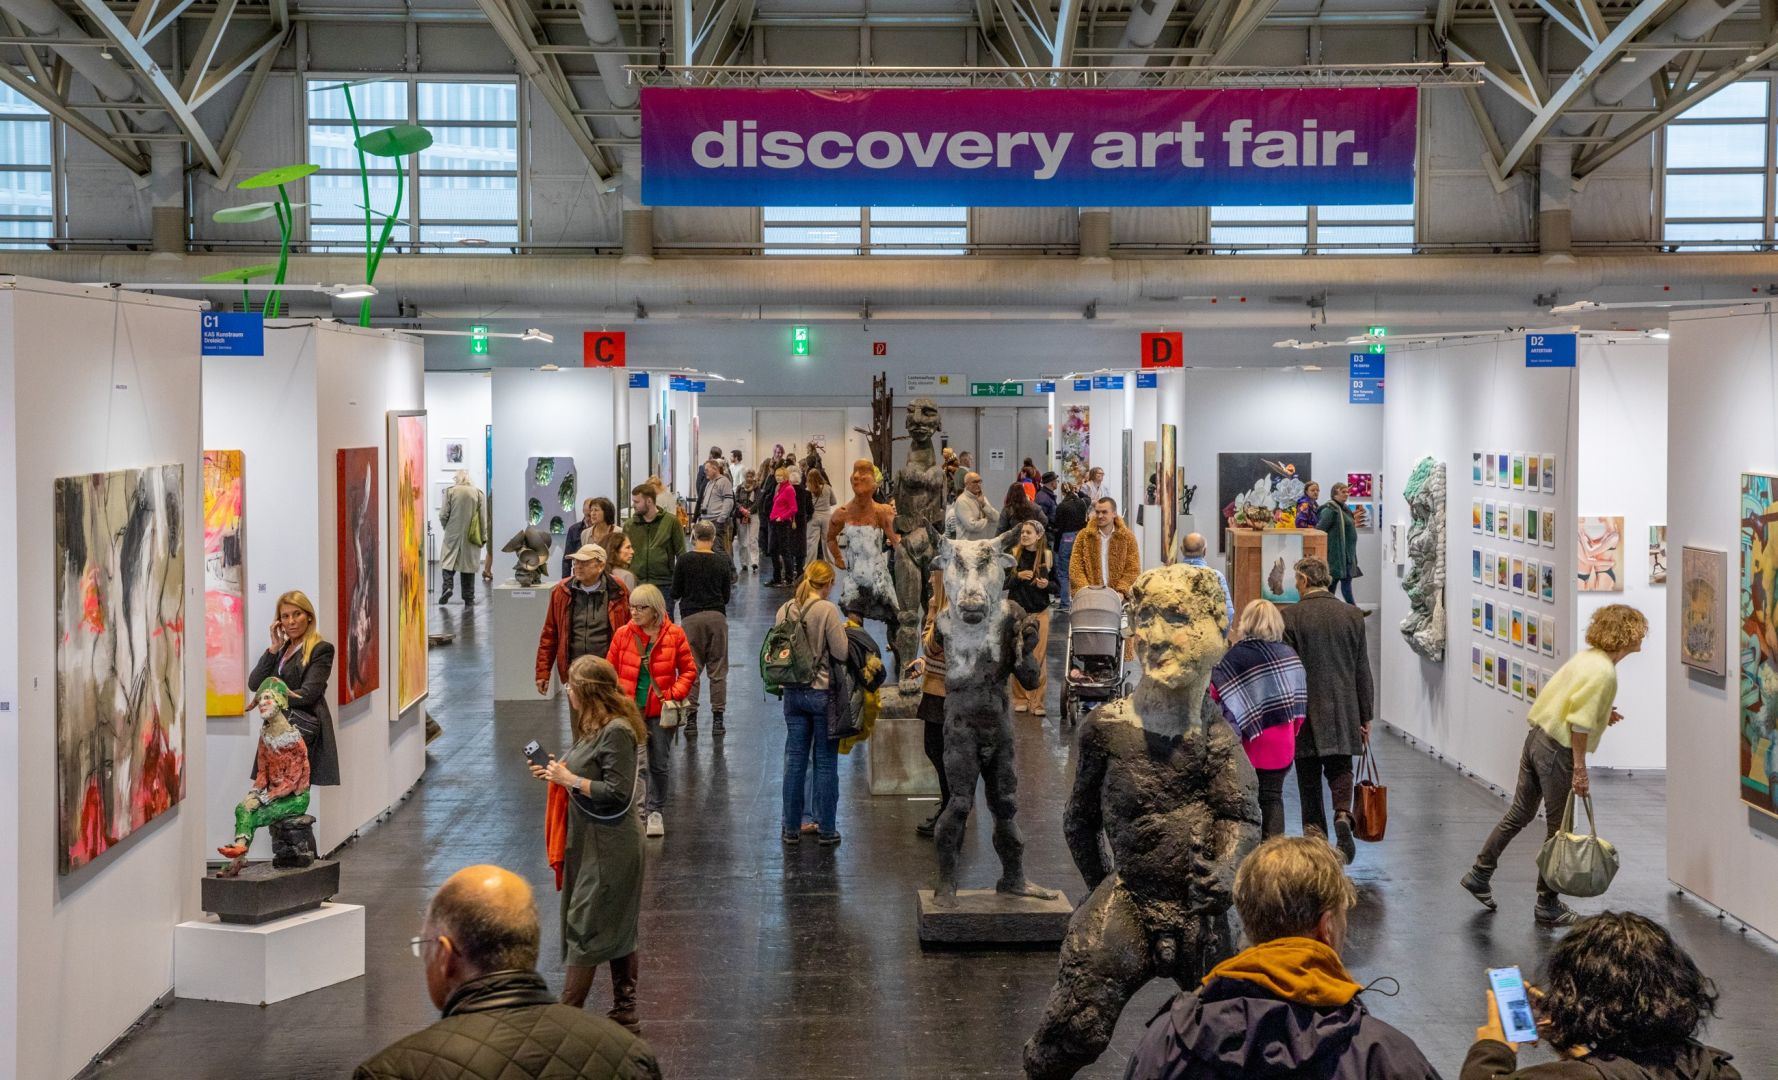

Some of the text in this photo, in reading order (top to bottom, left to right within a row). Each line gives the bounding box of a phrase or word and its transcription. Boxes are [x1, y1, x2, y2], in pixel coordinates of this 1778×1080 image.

[691, 118, 1369, 180] discovery art fair.
[203, 315, 219, 328] C1
[1310, 323, 1317, 332] K
[1530, 336, 1544, 346] D2
[595, 336, 615, 363] C
[1152, 337, 1172, 363] D
[1353, 354, 1364, 363] D3
[1353, 380, 1364, 389] D3
